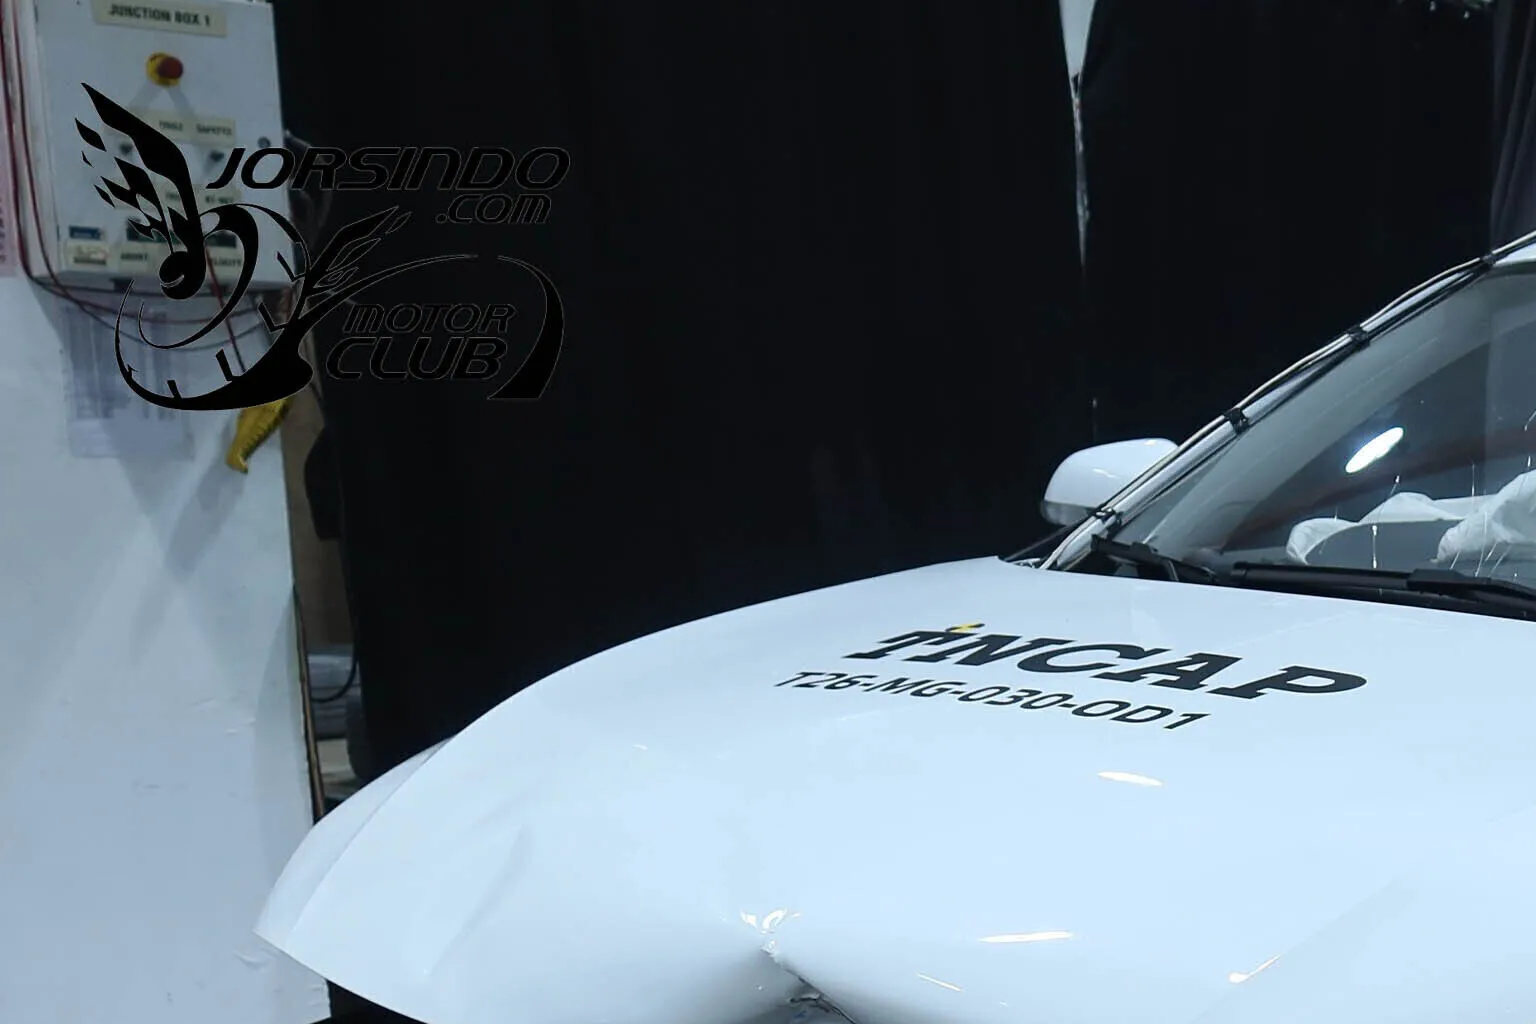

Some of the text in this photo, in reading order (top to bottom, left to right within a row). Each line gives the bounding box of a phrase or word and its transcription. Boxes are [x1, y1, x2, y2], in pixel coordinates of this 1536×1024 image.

[109, 4, 172, 22] JUNCTION
[174, 10, 199, 25] BOX
[842, 623, 1367, 700] TNCAP
